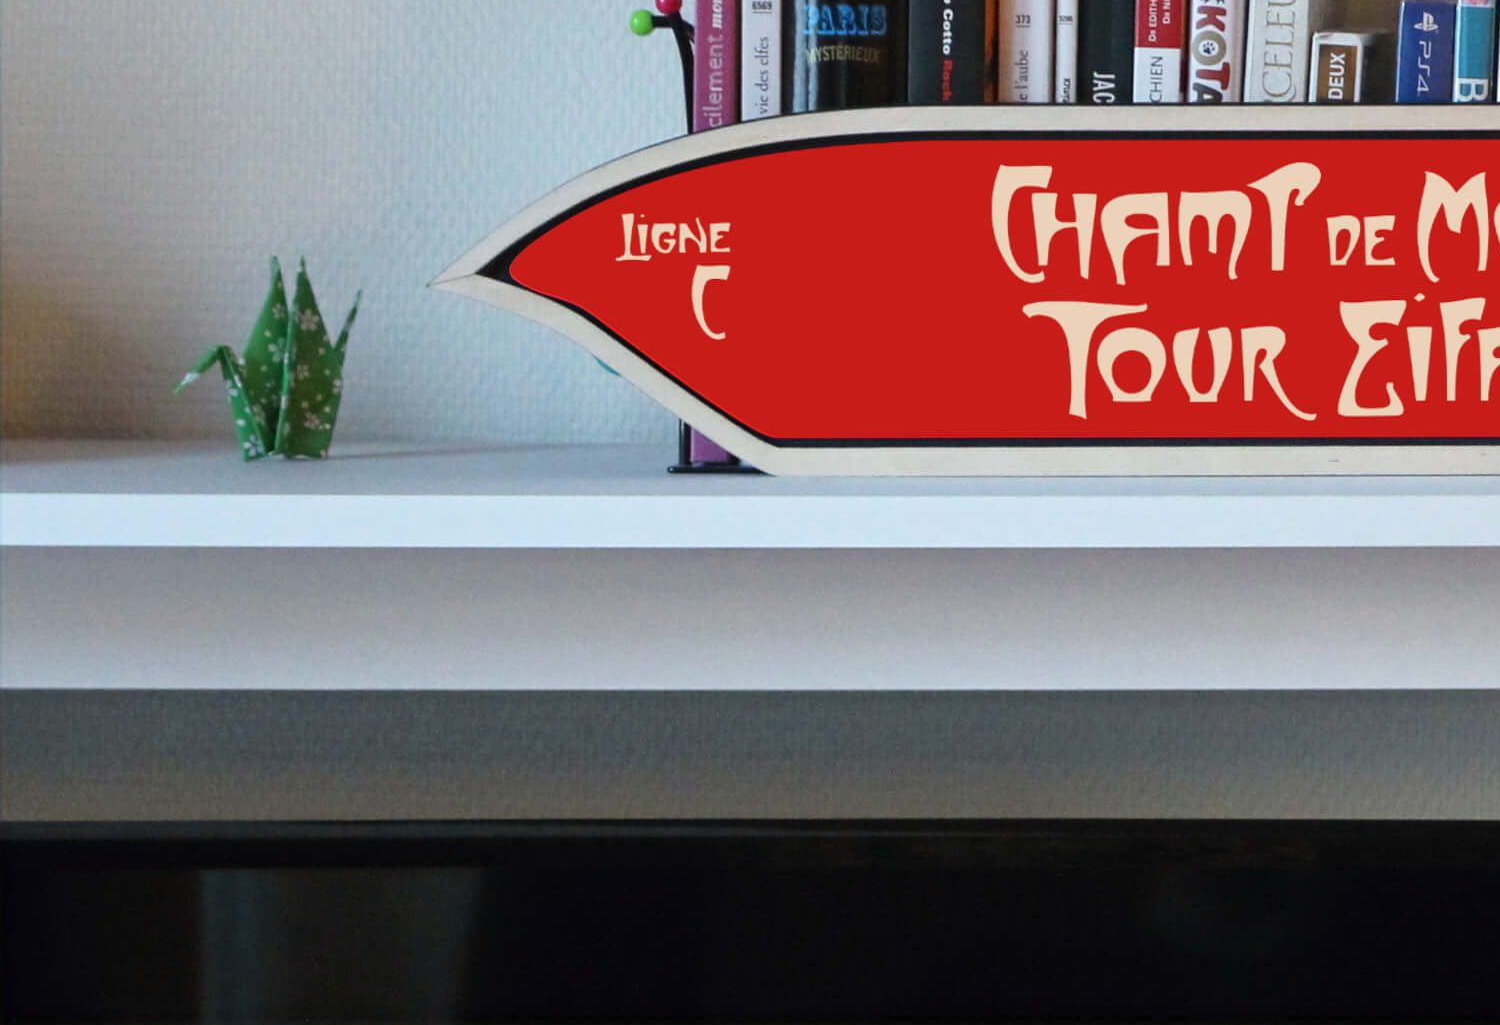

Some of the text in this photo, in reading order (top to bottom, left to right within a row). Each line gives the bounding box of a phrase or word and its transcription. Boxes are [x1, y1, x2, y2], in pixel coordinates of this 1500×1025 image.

[803, 4, 887, 36] PARIS
[942, 8, 954, 56] Cotto
[1015, 14, 1032, 24] 373
[1149, 0, 1158, 28] EDITH
[753, 36, 769, 115] vie des elfes
[1149, 55, 1164, 103] CHIEN
[1327, 51, 1347, 101] DEUX
[1416, 40, 1432, 97] PS4
[691, 265, 731, 340] C
